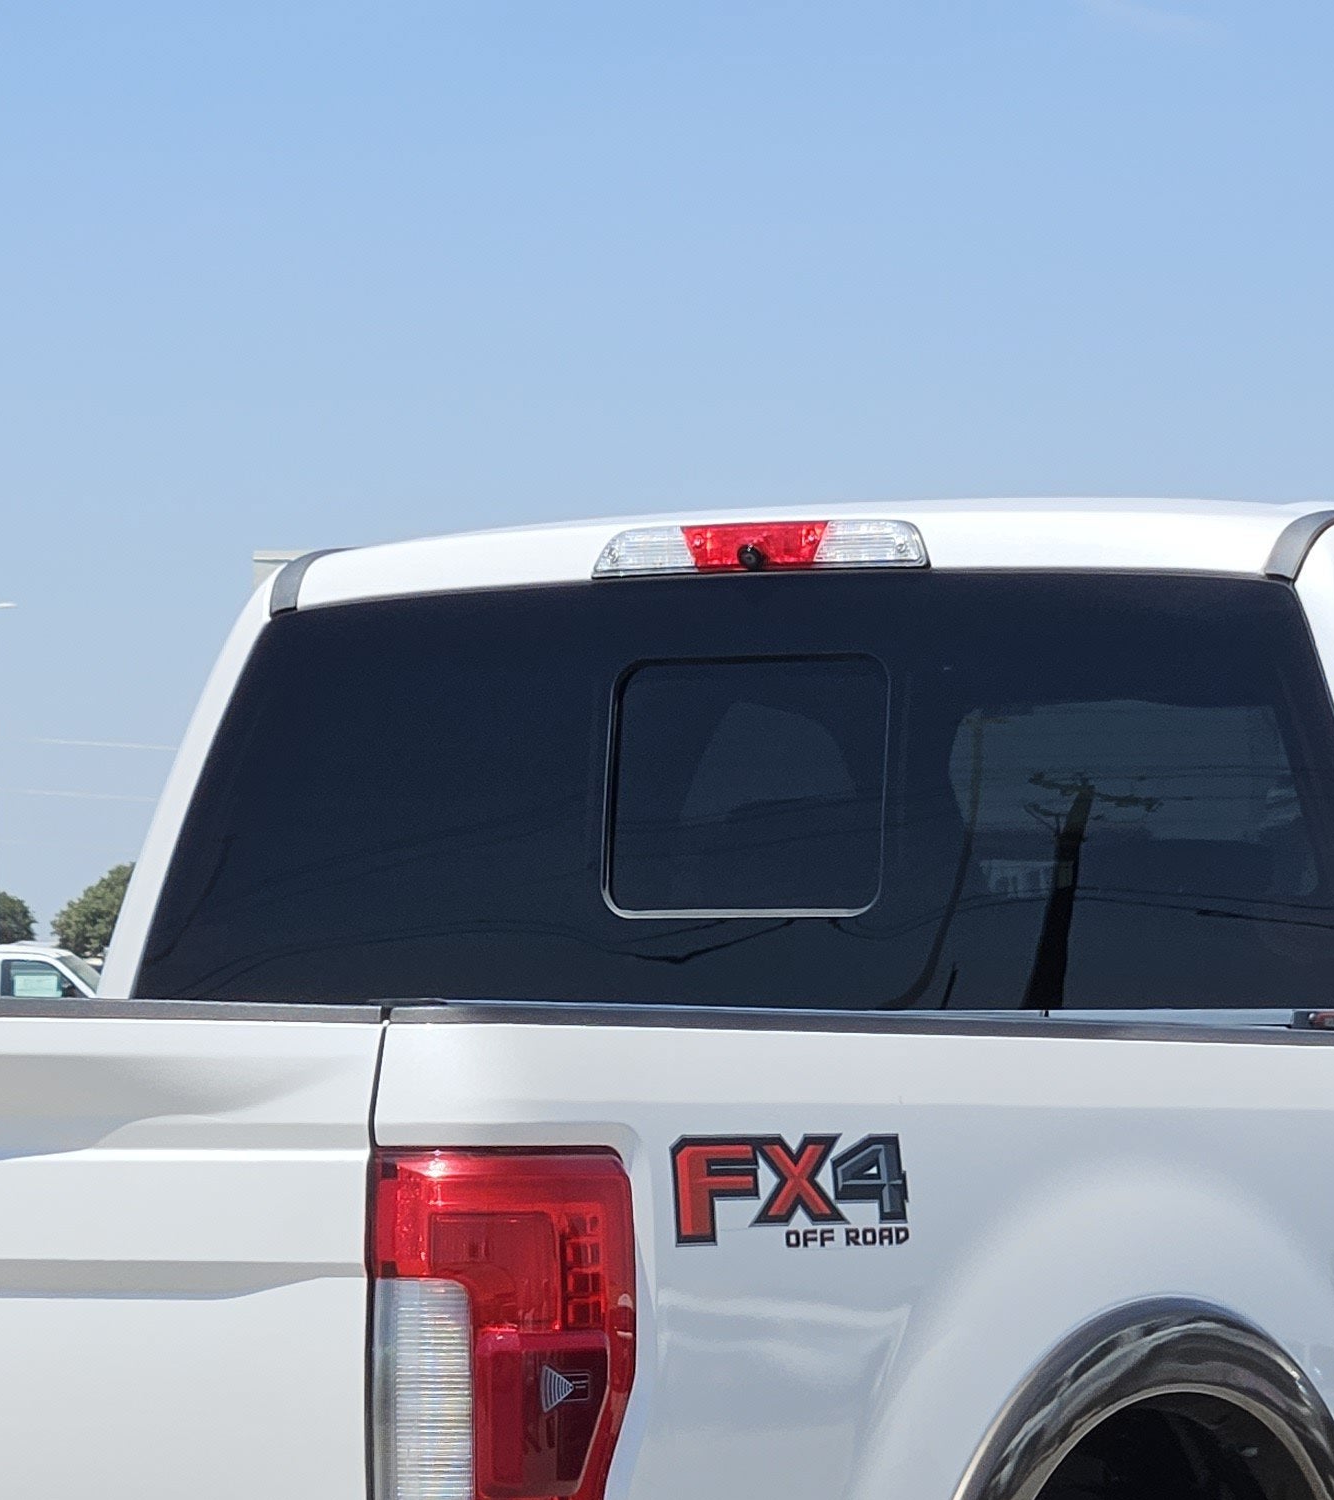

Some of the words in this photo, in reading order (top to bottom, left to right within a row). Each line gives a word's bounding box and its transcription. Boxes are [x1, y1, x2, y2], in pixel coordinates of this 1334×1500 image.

[669, 1132, 909, 1247] FX4
[785, 1227, 835, 1248] OFF
[845, 1226, 910, 1247] ROAD
